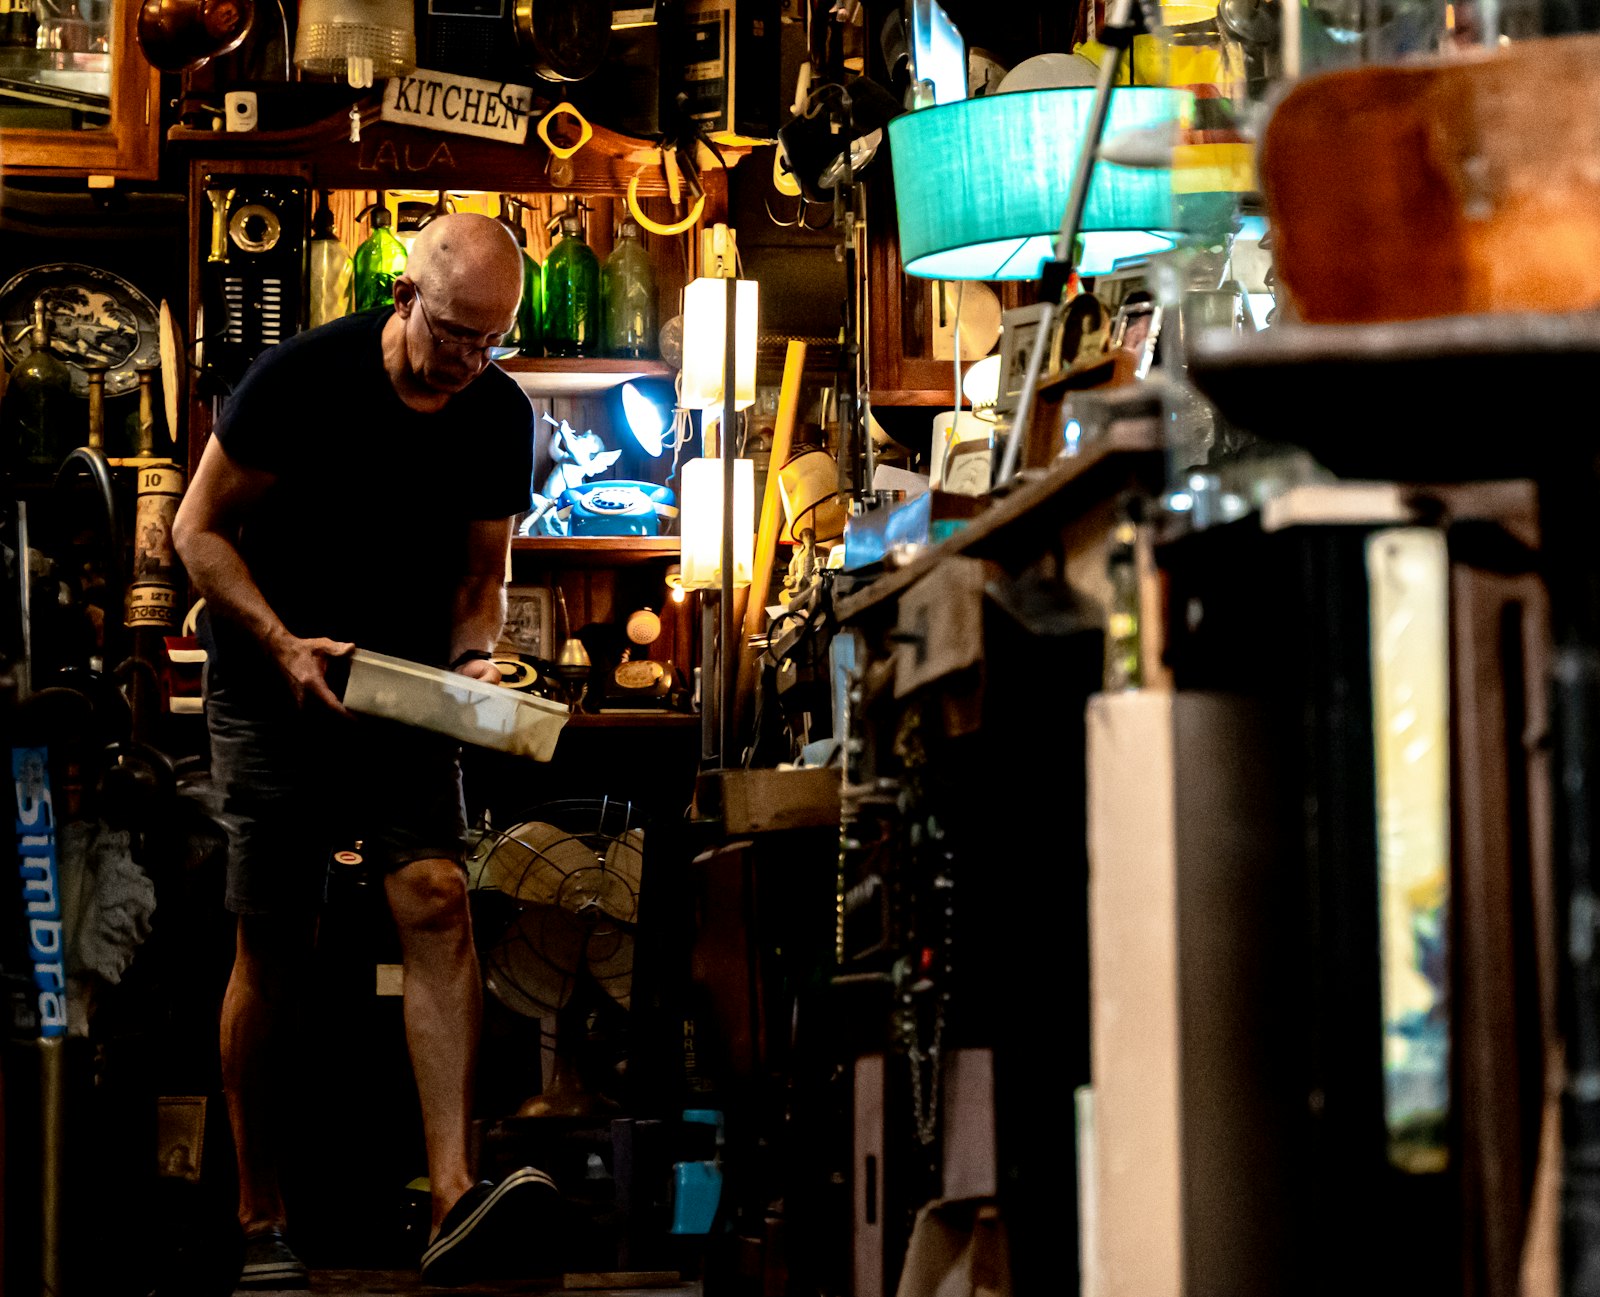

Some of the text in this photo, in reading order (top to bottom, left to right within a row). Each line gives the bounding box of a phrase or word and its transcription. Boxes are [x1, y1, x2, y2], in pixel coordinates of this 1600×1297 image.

[394, 76, 524, 131] KITCHEN
[144, 473, 162, 488] 10
[16, 781, 67, 1027] Simbra
